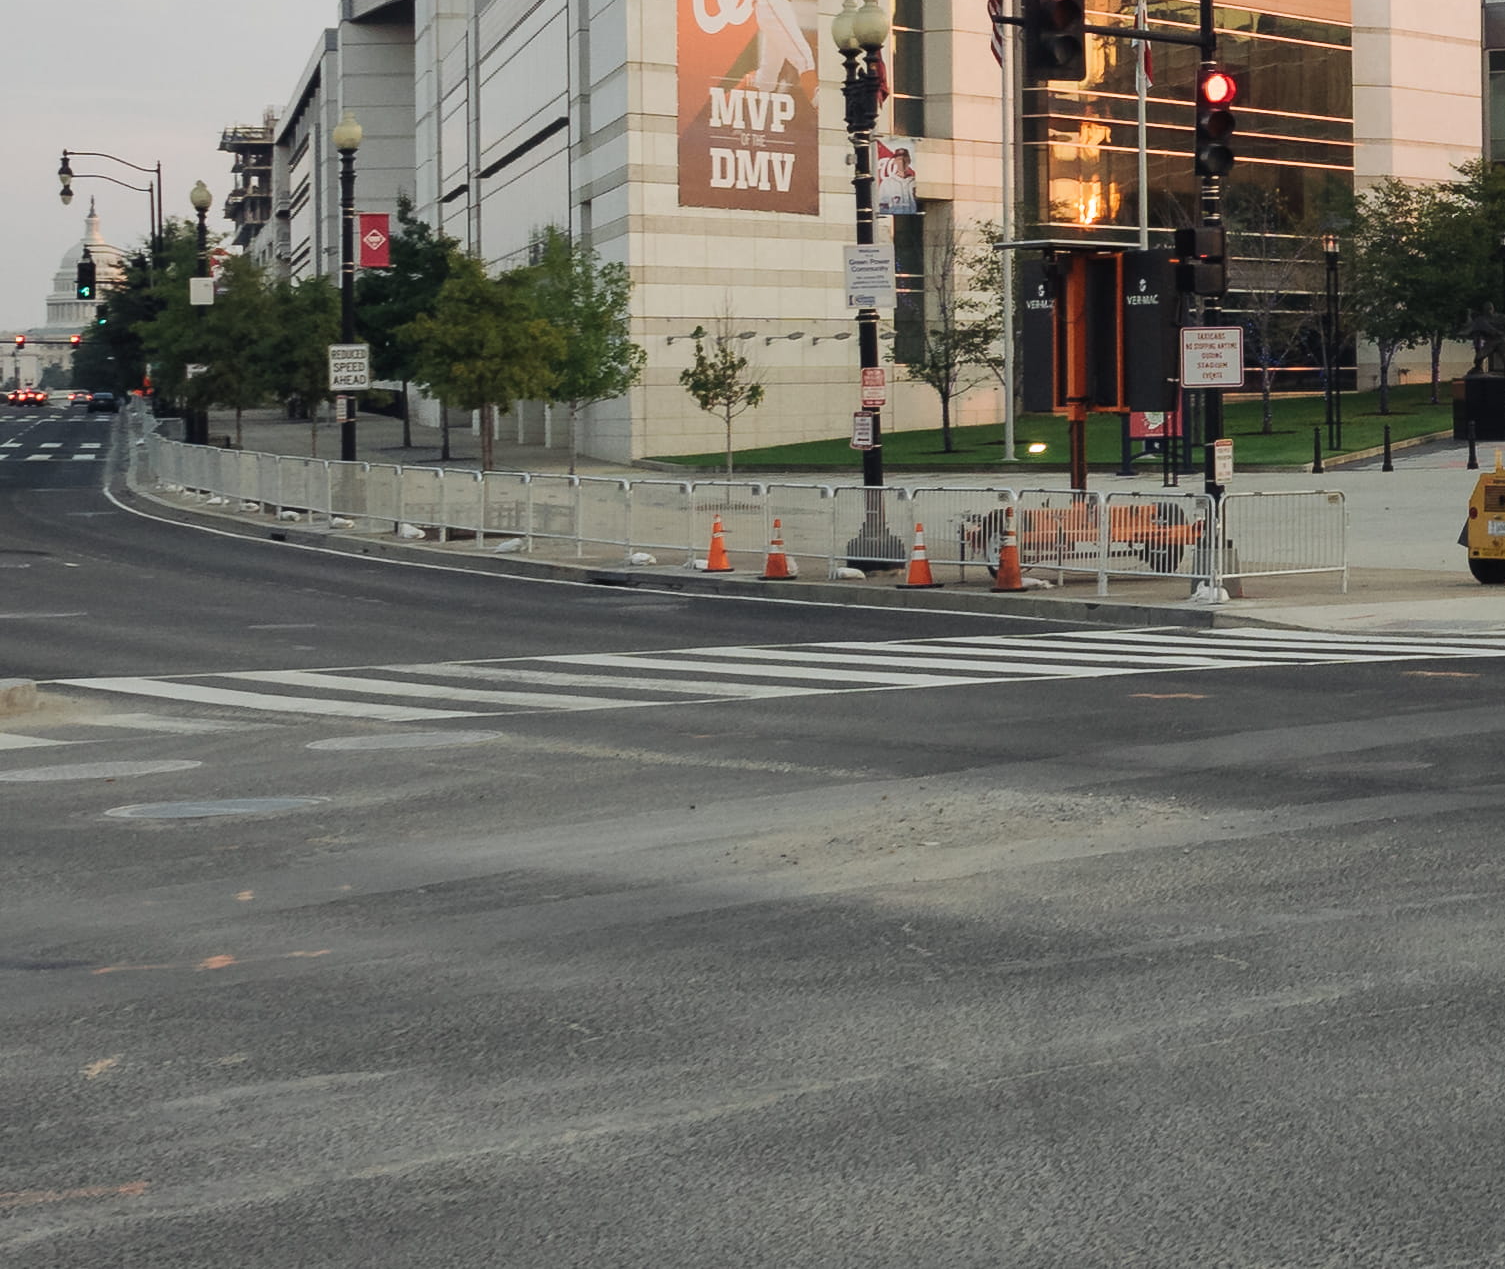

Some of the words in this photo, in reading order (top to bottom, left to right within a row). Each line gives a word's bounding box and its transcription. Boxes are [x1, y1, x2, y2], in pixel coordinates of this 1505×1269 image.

[709, 86, 796, 133] MVP
[741, 132, 751, 147] OF
[752, 133, 767, 147] THE
[709, 147, 796, 192] DMV
[1197, 332, 1226, 340] TAXICABS
[1194, 342, 1216, 350] STOPPING
[331, 349, 366, 360] REDUCED
[333, 361, 366, 373] SPEED
[1196, 361, 1228, 369] STADIUM
[333, 374, 366, 386] AHEAD
[1202, 371, 1223, 379] EVENTS
